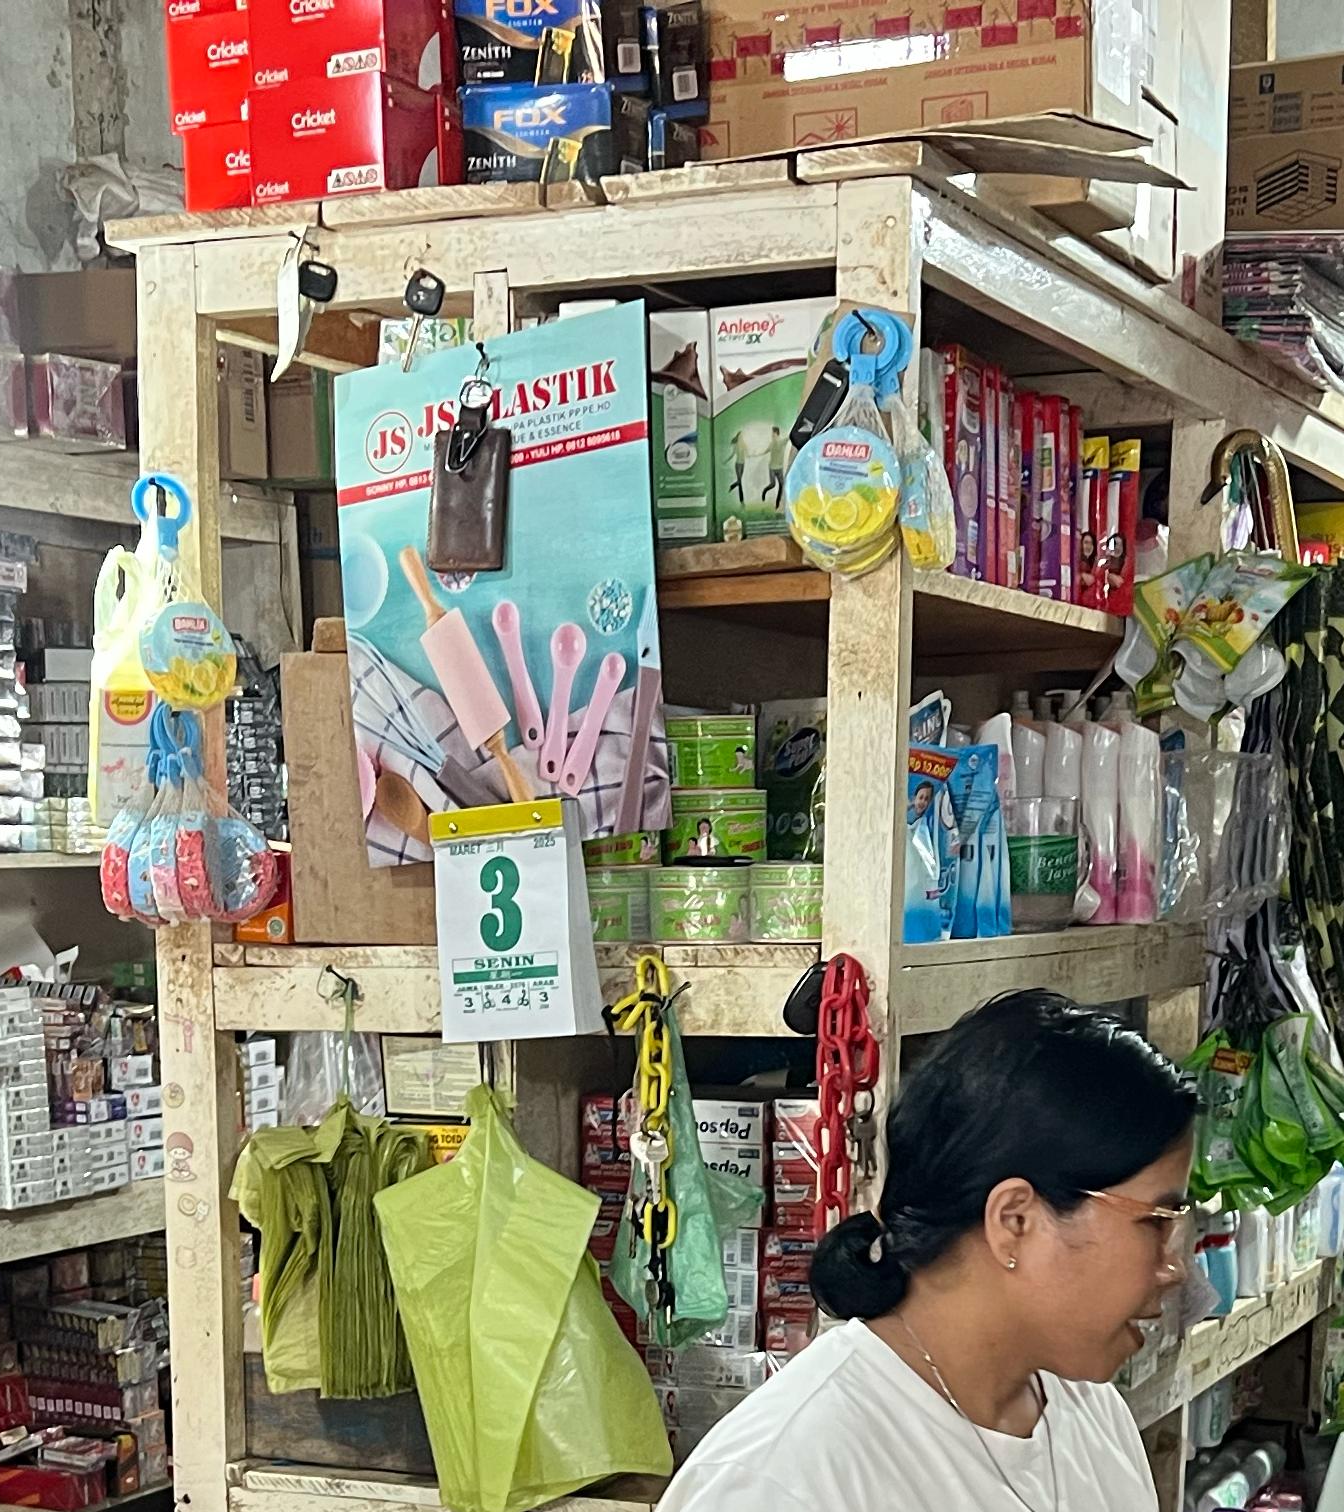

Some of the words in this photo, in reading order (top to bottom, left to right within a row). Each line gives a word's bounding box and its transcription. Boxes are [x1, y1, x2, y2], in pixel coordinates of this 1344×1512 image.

[207, 40, 248, 60] Cricket
[255, 68, 288, 85] Cricket
[175, 110, 206, 126] Cricket
[291, 108, 336, 130] Cricket
[494, 104, 567, 130] FOX
[225, 149, 250, 168] Cric
[256, 181, 289, 197] Cricket
[717, 316, 772, 335] Anlene
[416, 400, 454, 438] JS
[491, 360, 617, 421] LASTIK
[537, 419, 582, 441] ESSENCE
[373, 426, 406, 460] JS
[480, 856, 522, 951] 3
[474, 954, 535, 970] SENIN
[697, 1117, 752, 1141] Pepso
